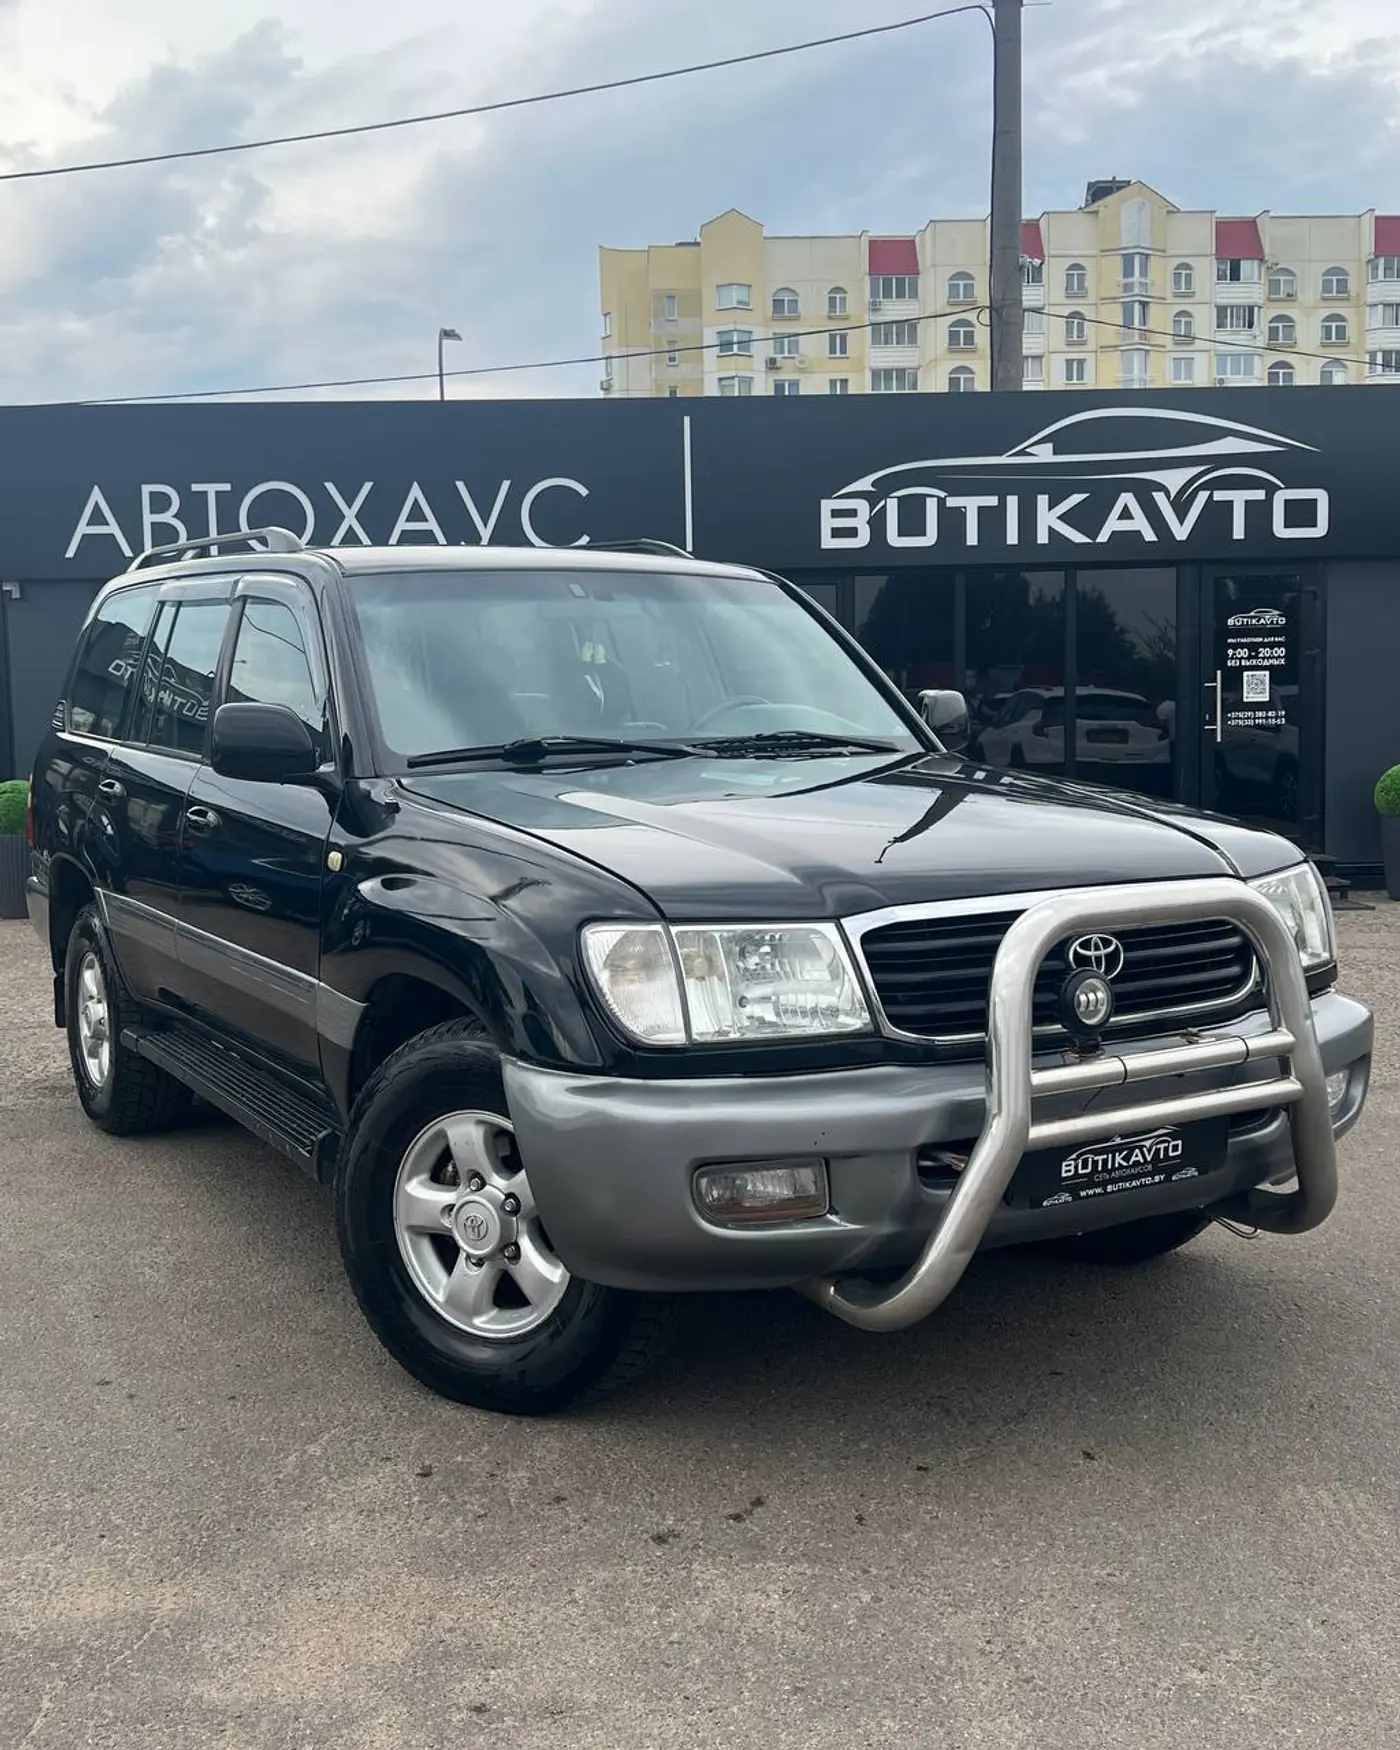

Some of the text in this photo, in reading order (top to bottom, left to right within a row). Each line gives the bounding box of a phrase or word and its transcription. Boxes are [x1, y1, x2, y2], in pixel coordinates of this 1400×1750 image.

[65, 477, 590, 559] АВТОХАУС
[820, 487, 1330, 549] BUTIKAVTO
[1227, 616, 1287, 626] BUTIKAVTO
[1227, 648, 1249, 658] 9:00
[1258, 647, 1286, 657] 20:00
[1227, 658, 1286, 667] БЕЗ ВЫХОДНЫХ
[1061, 1139, 1183, 1178] BUTIKAVTO
